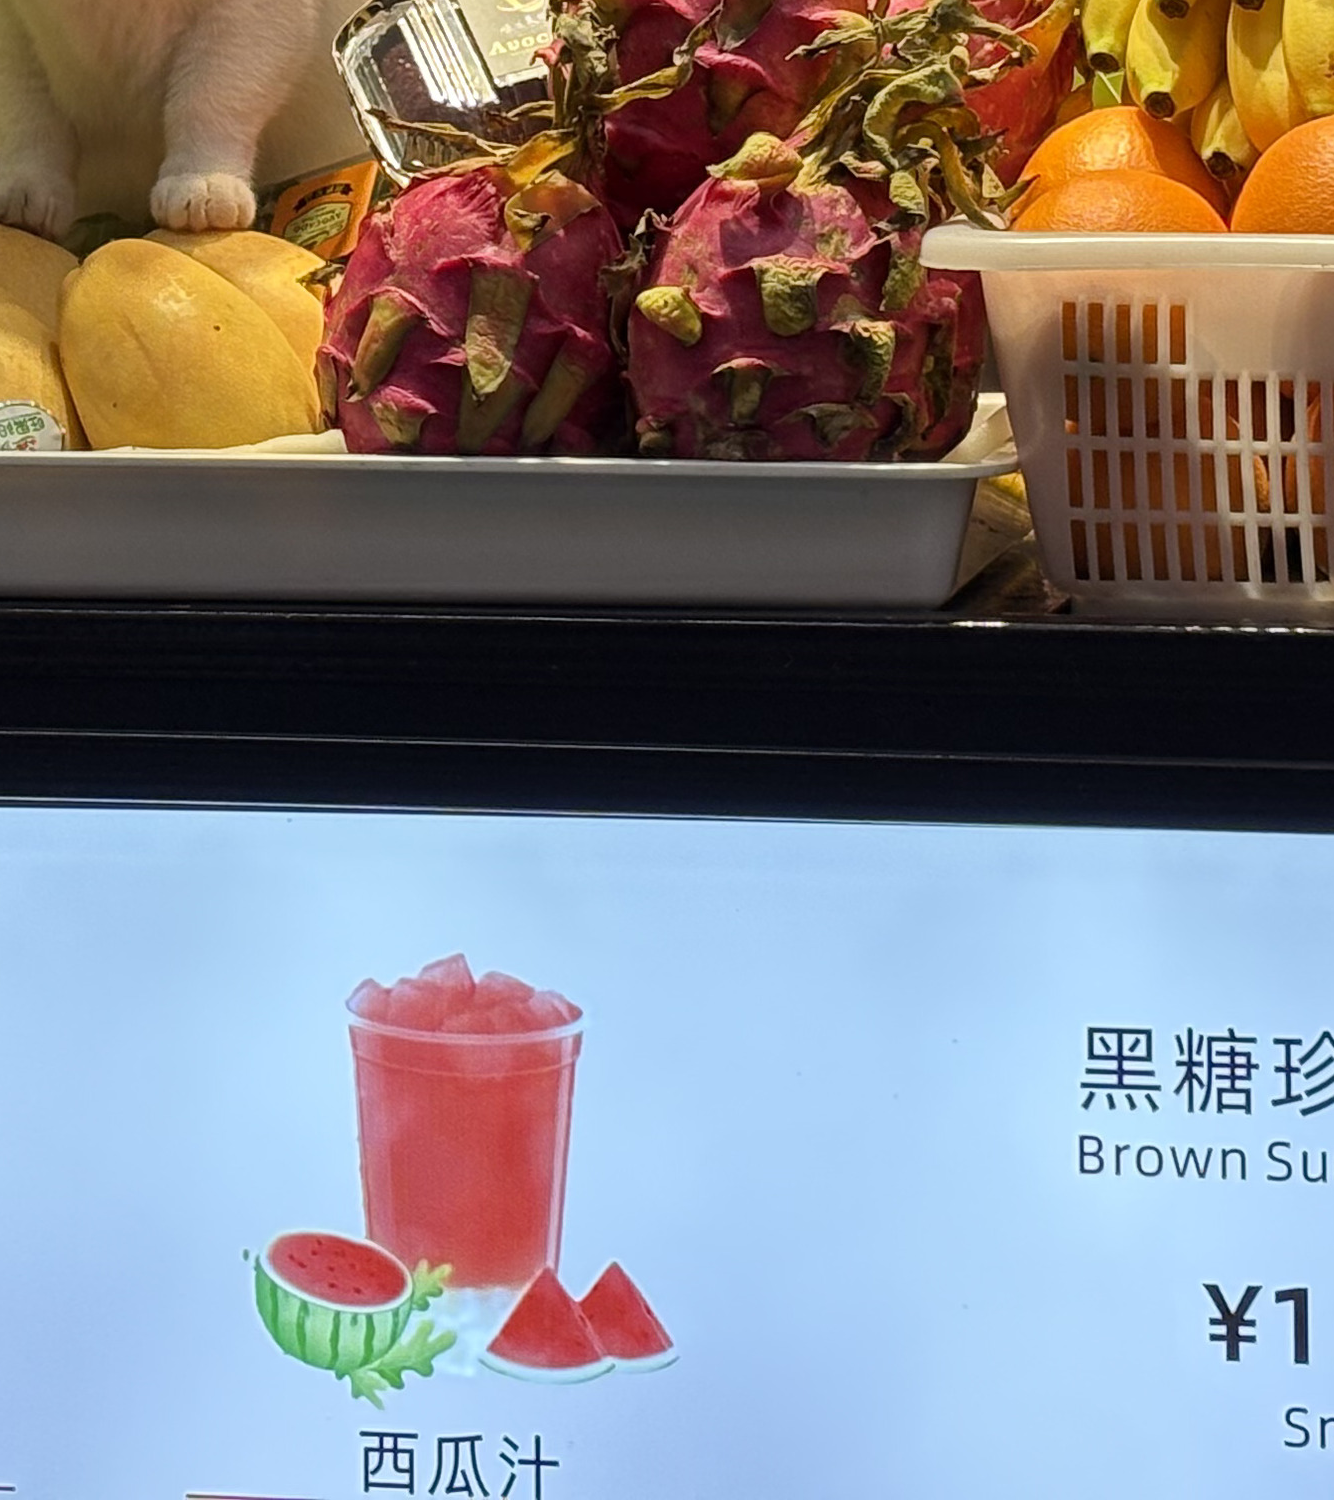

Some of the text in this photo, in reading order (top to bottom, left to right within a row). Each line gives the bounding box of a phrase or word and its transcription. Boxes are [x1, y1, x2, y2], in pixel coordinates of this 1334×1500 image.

[488, 31, 550, 57] Avoc
[1077, 1134, 1247, 1181] Brown
[358, 1430, 560, 1500] 西瓜汁
